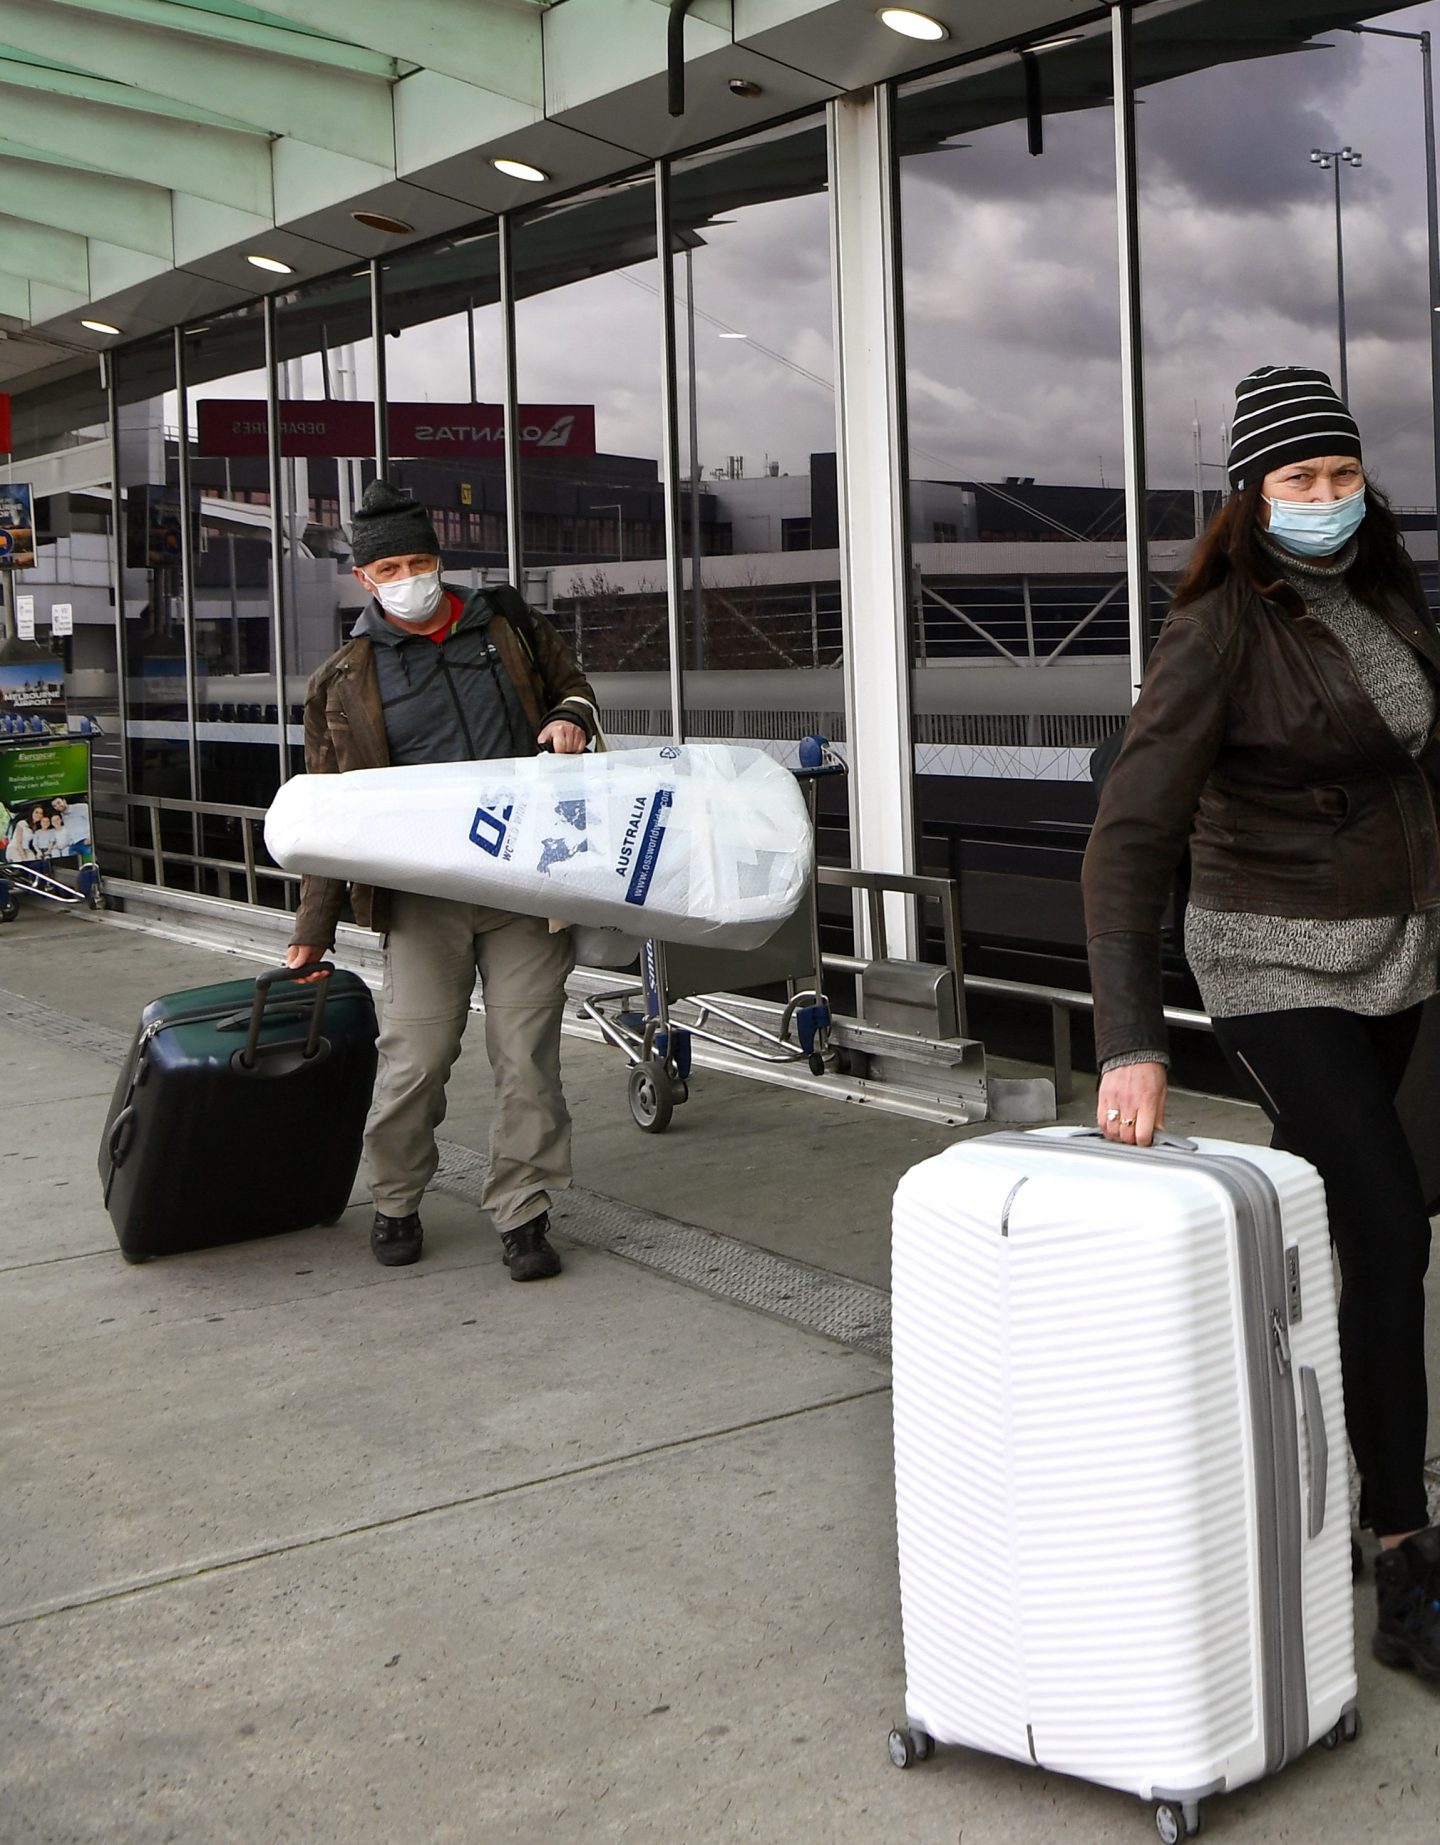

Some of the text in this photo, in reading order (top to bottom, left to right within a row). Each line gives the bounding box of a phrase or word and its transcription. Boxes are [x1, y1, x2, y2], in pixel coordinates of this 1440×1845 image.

[4, 691, 60, 701] MELBOURNE
[14, 698, 52, 707] AIRPORT
[615, 797, 647, 877] AUSTRALIA
